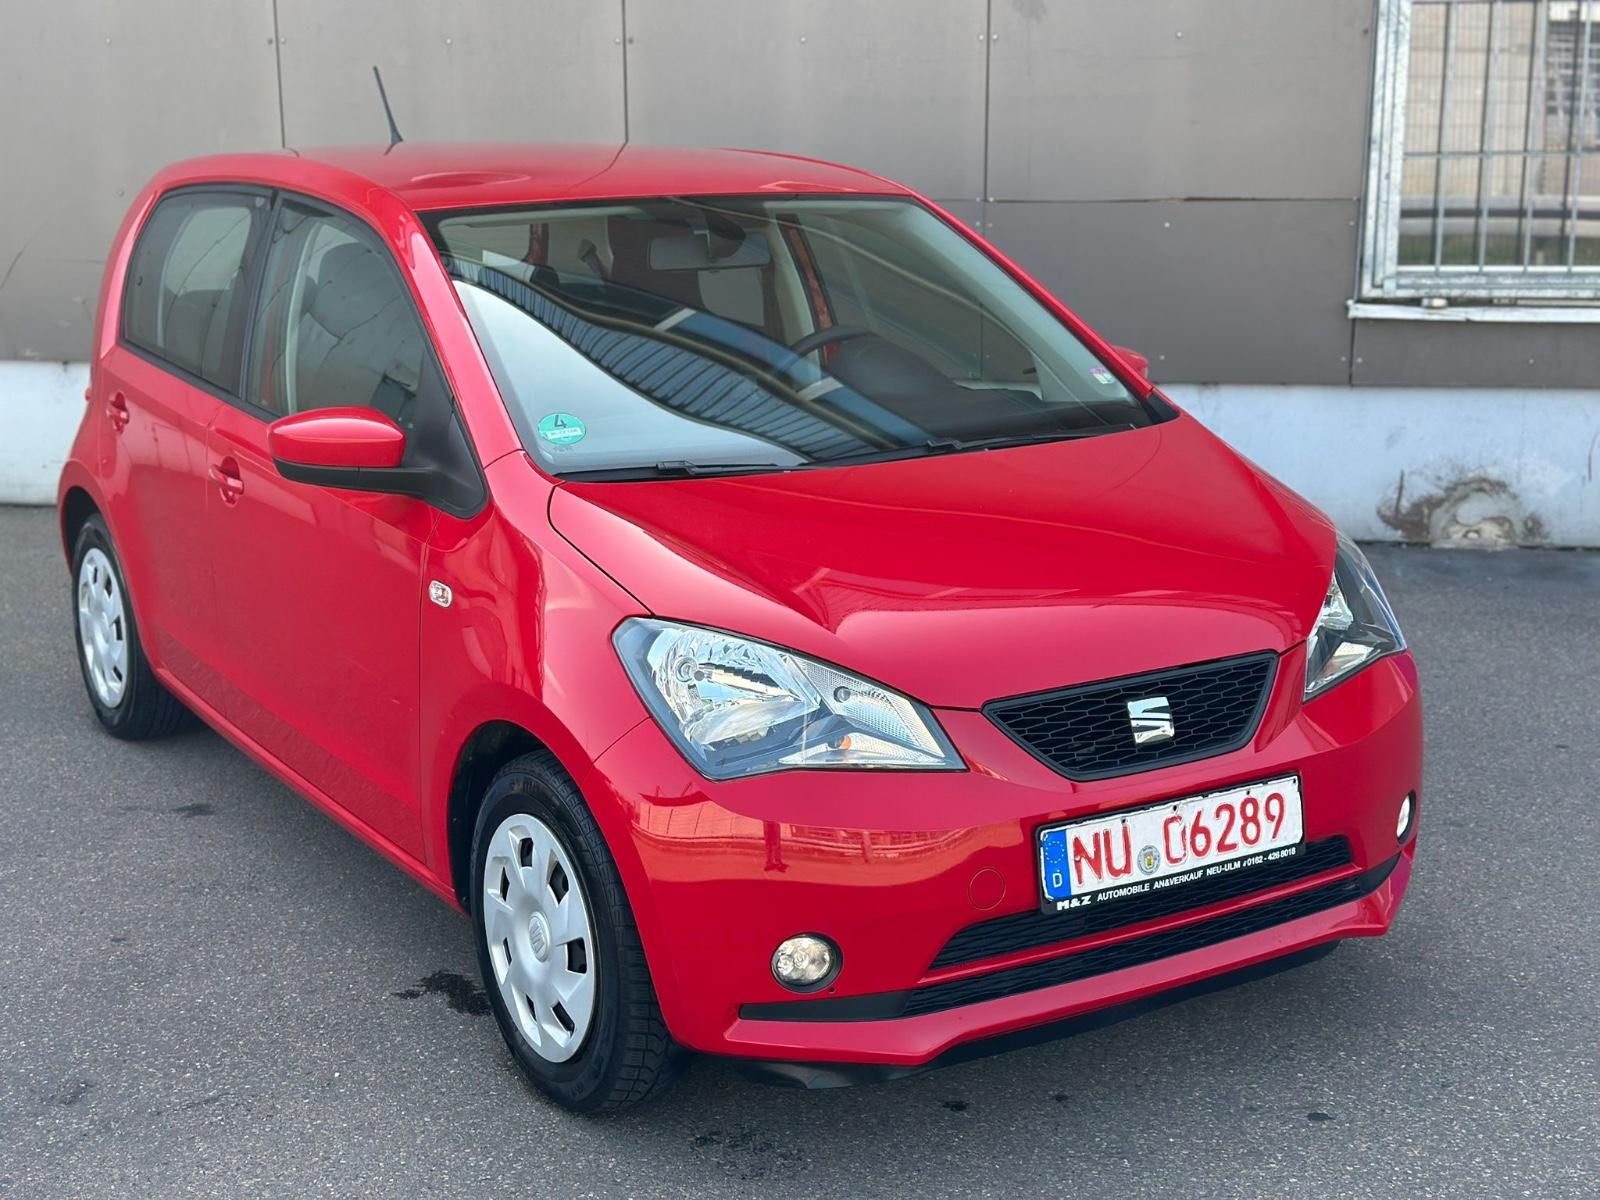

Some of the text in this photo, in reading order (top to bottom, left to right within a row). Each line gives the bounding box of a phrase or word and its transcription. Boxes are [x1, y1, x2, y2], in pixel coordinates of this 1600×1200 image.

[554, 414, 567, 428] 4
[1072, 824, 1134, 885] NU
[1052, 872, 1063, 888] D
[1056, 895, 1092, 911] M&Z
[1097, 883, 1150, 902] AUTOMOBILE
[1153, 870, 1204, 889] AN&VERKAUF
[1206, 860, 1241, 876] NEU-ULM
